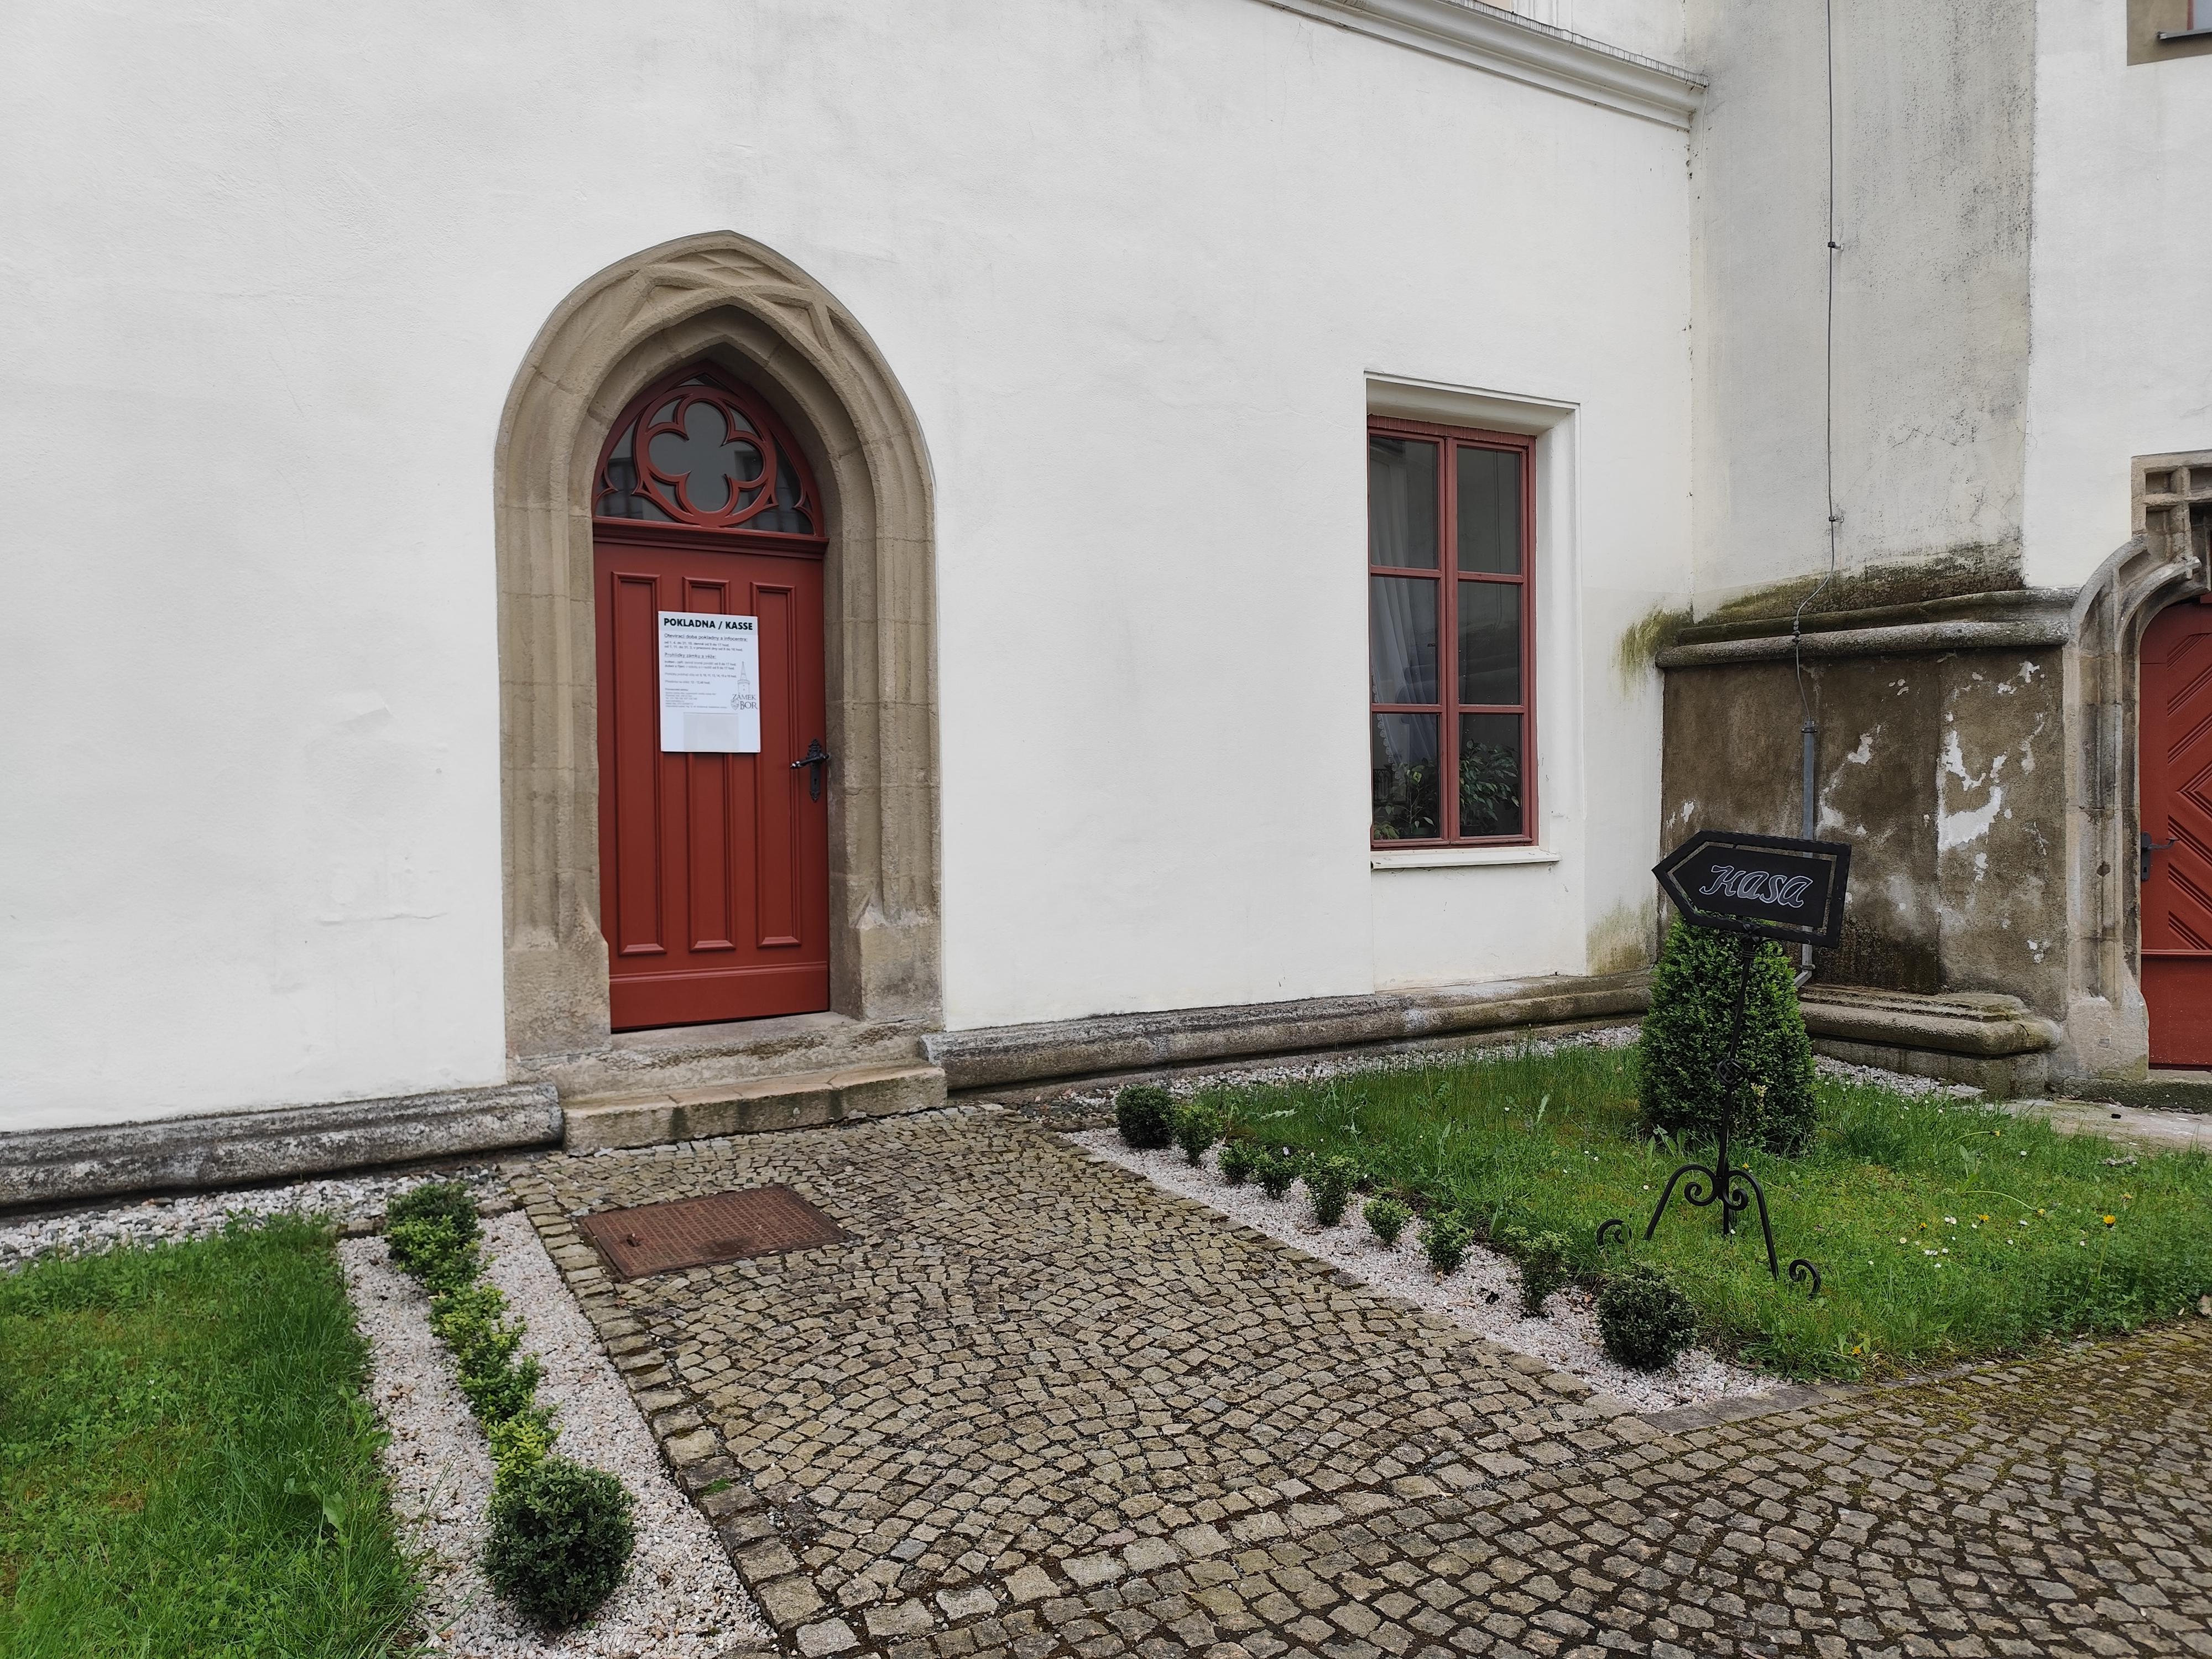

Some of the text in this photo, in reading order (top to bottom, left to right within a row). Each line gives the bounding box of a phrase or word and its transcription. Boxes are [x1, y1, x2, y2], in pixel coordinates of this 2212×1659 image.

[664, 618, 716, 629] POKLADNA
[725, 621, 753, 630] KASSE
[740, 701, 758, 710] BOR
[1698, 864, 1814, 909] Kasa
